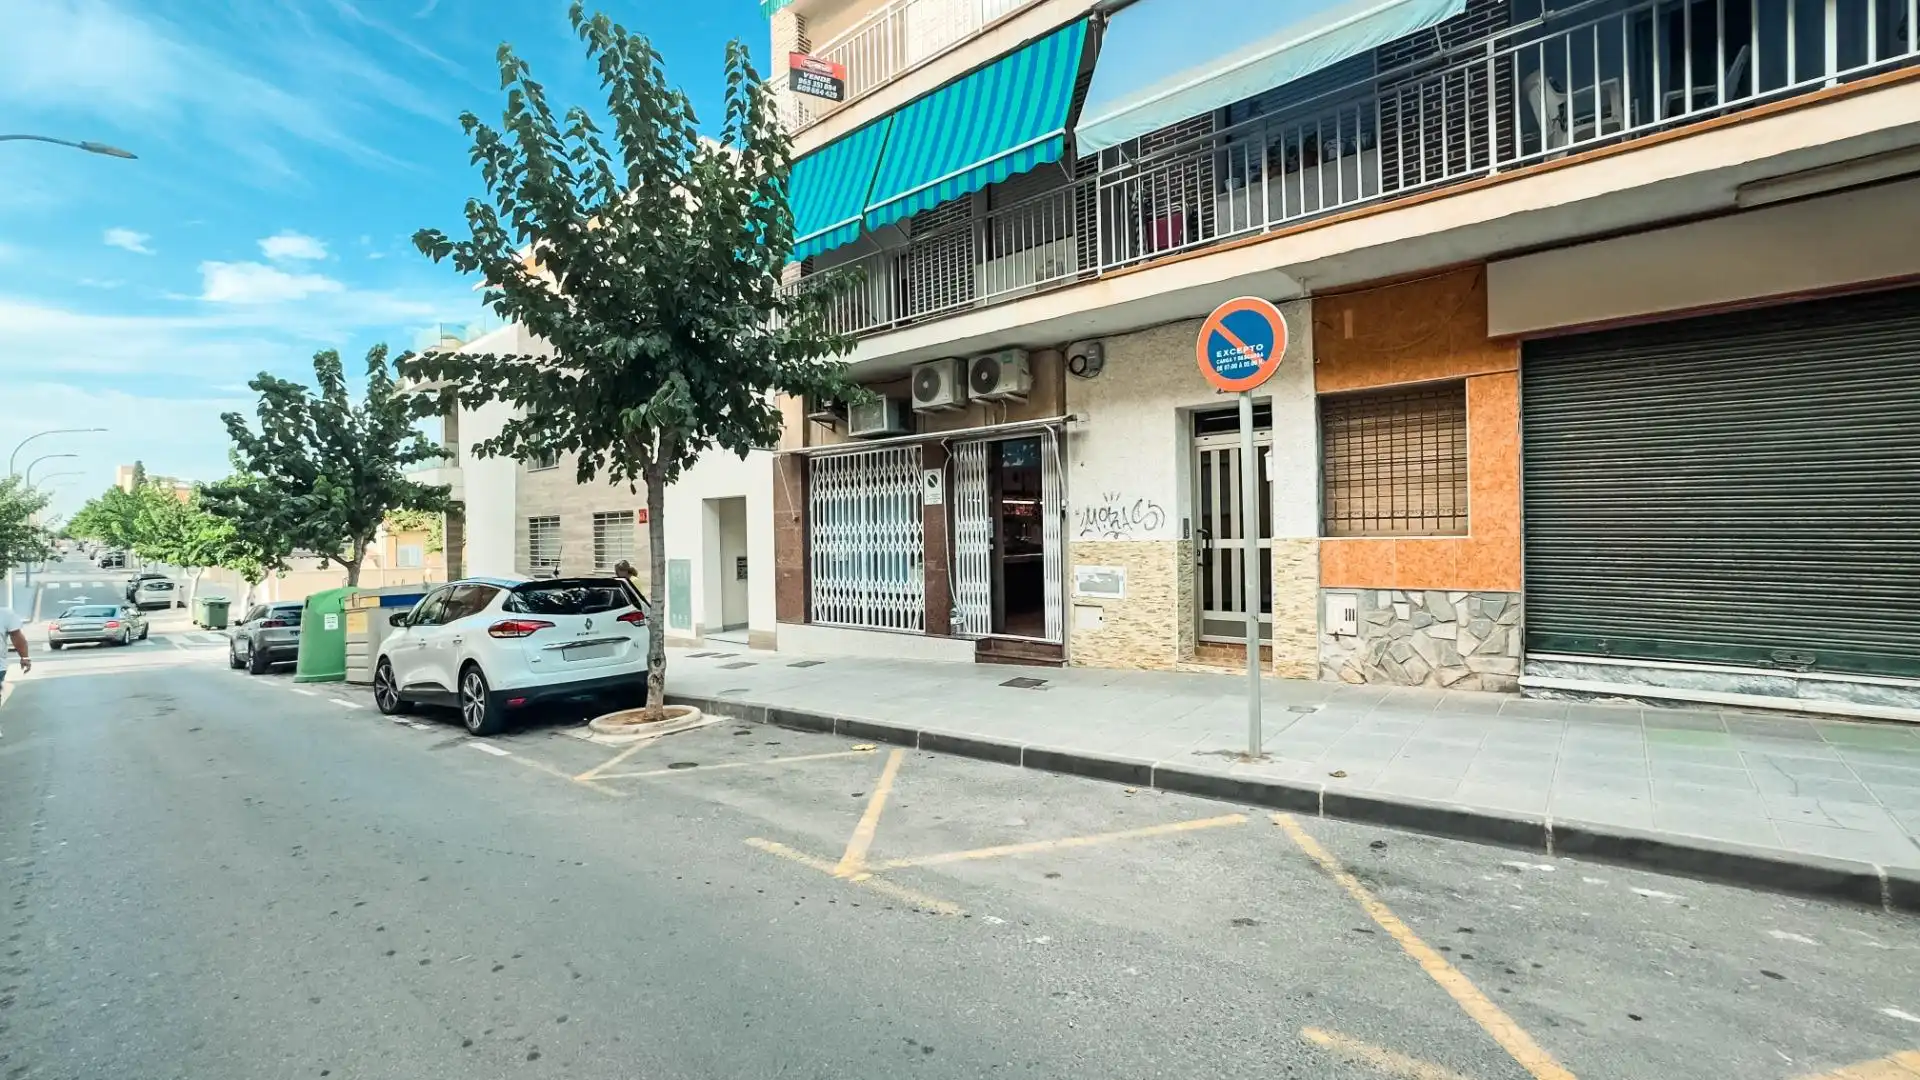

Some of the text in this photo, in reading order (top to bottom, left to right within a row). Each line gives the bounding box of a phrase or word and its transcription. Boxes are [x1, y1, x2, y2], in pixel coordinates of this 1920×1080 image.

[803, 72, 831, 84] VENDE
[1216, 344, 1264, 357] EXCEPTO
[1216, 357, 1232, 365] CARGA
